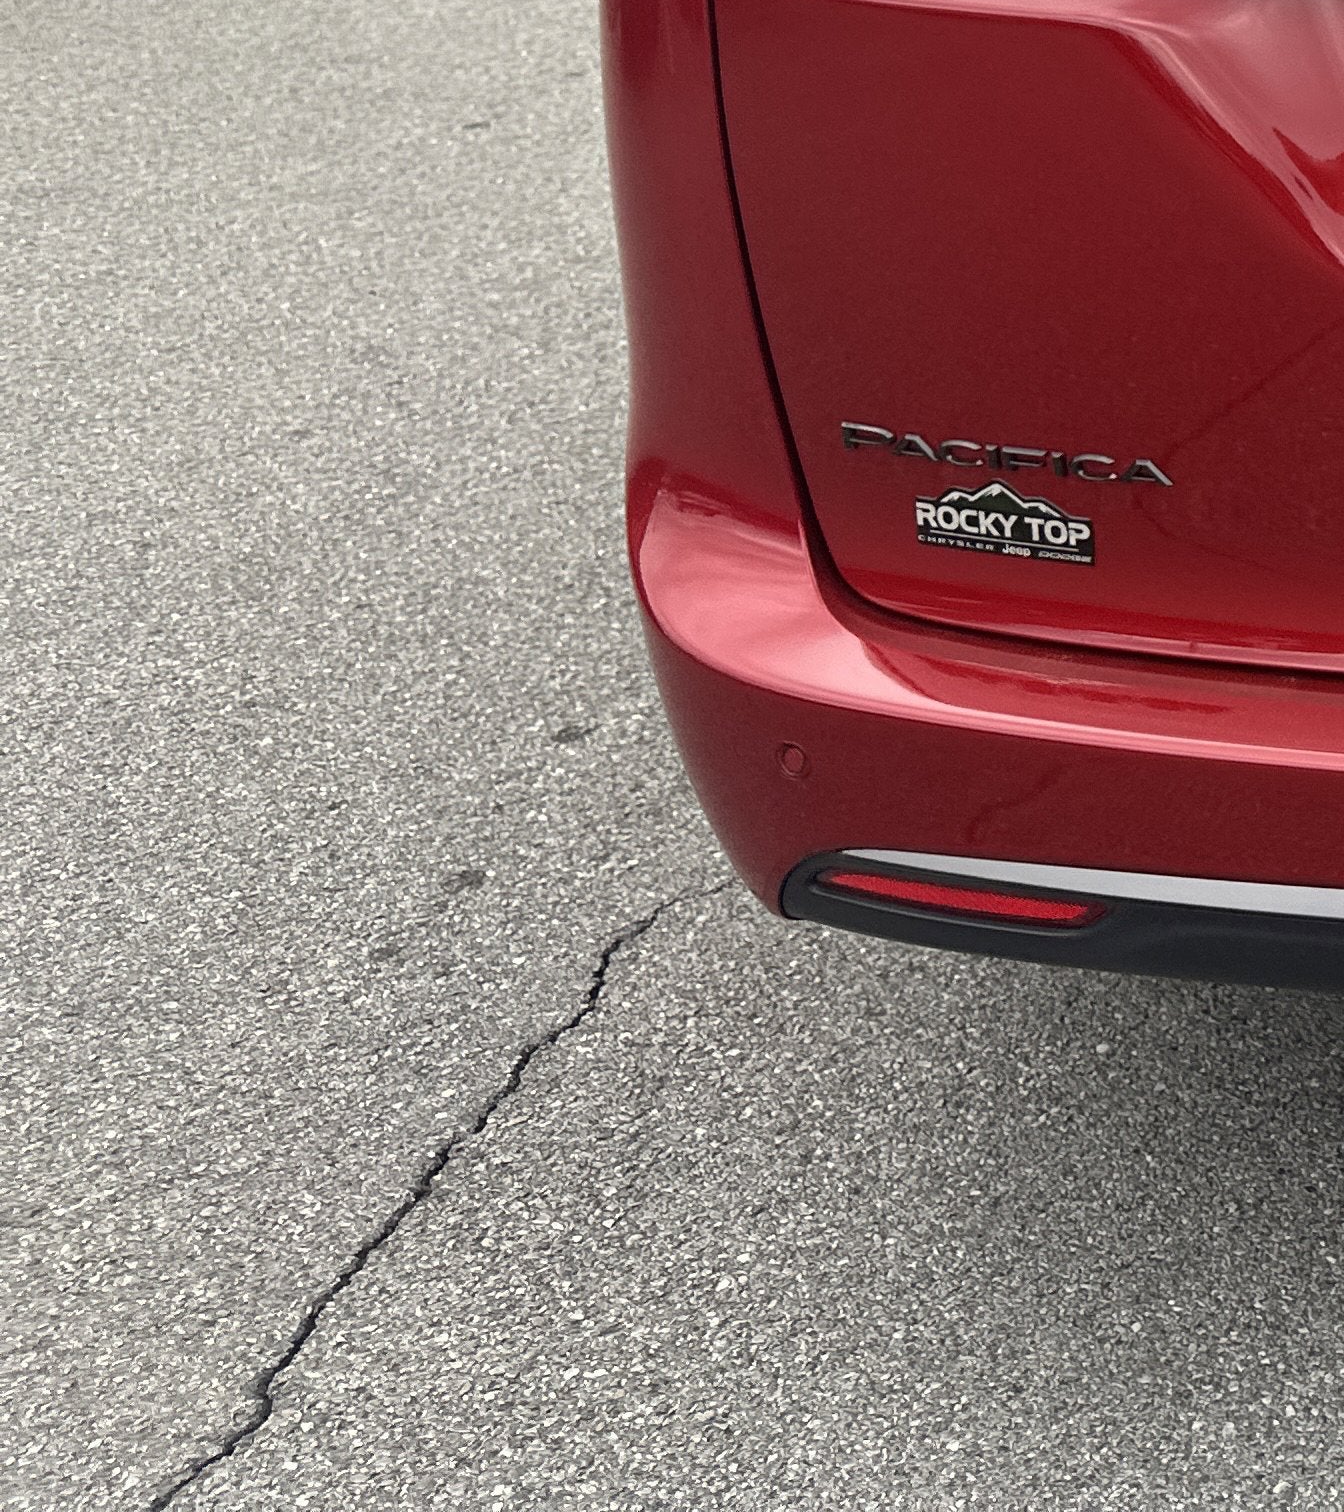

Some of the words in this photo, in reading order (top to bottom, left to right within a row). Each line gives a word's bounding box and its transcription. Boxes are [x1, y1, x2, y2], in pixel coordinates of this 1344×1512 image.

[841, 421, 1174, 487] PACIFICA
[915, 501, 1018, 538] ROCKY
[1024, 516, 1091, 546] TOP
[917, 534, 995, 551] CHRYSLER
[1002, 543, 1031, 557] Jeep
